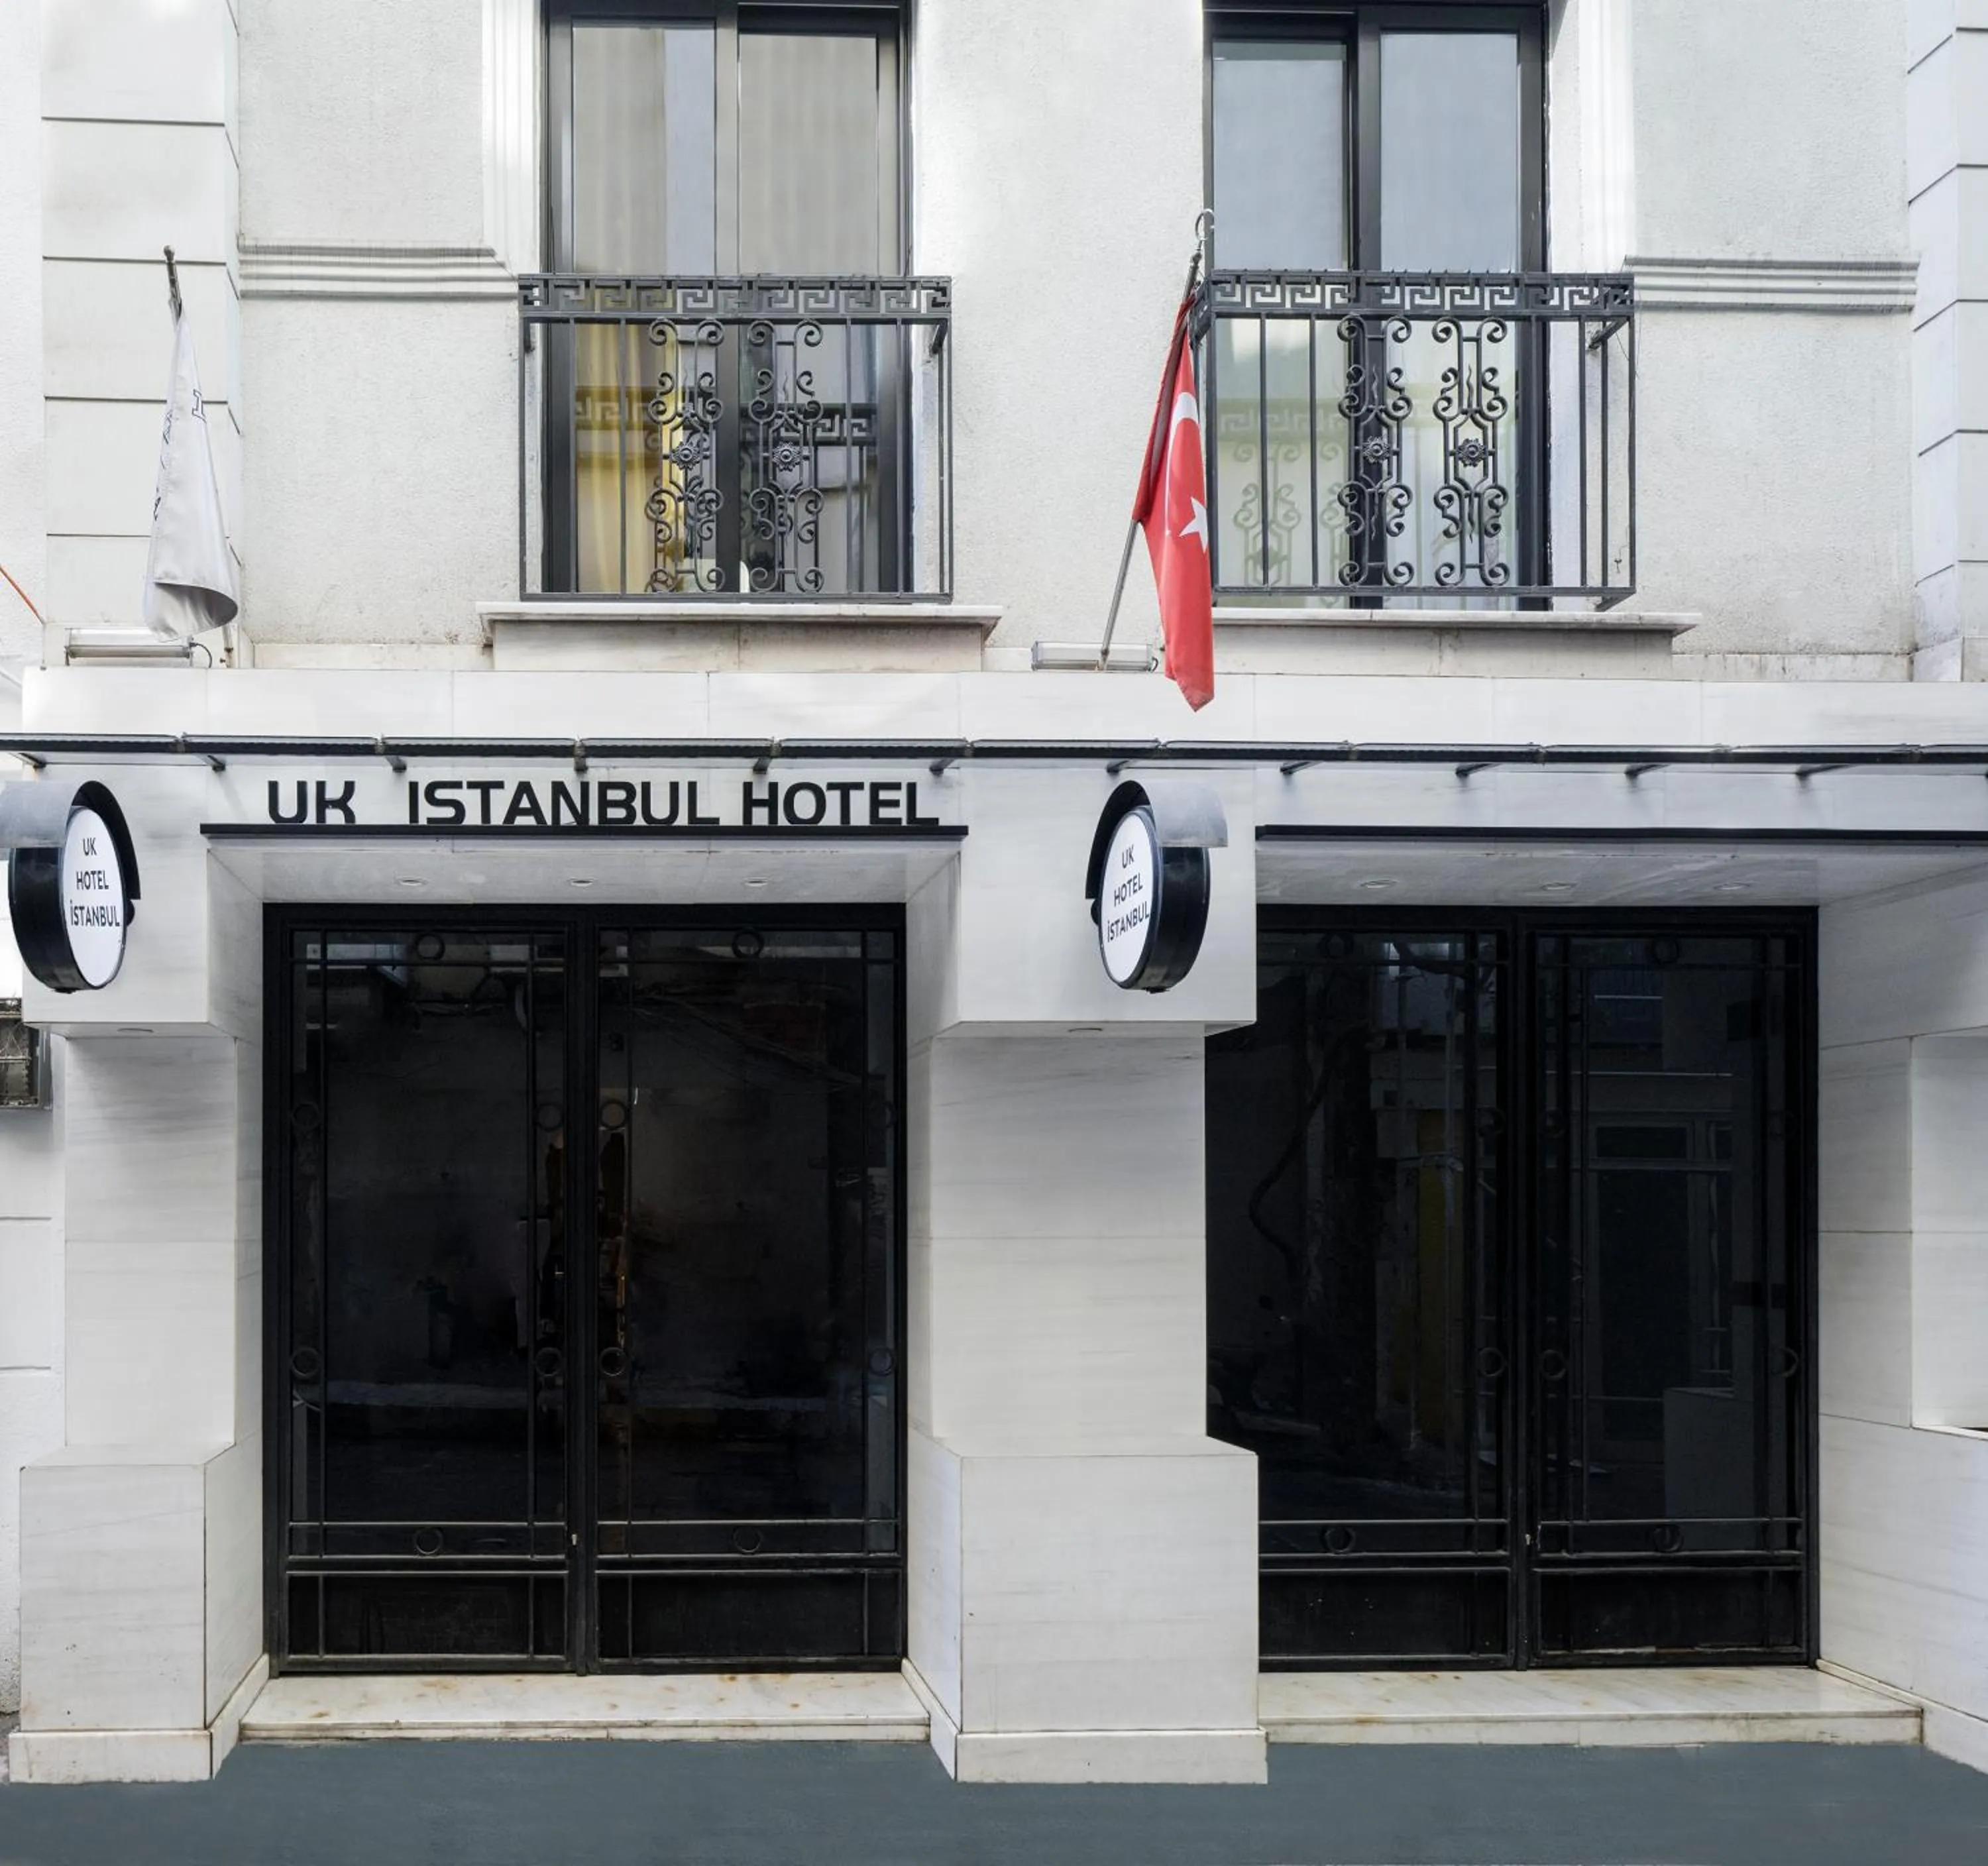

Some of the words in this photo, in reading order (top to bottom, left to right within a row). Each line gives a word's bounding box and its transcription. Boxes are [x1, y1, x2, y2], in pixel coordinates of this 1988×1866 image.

[268, 781, 357, 826] UK
[409, 781, 720, 826] ISTANBUL
[742, 781, 940, 826] HOTEL
[83, 838, 97, 856] UK
[1122, 845, 1134, 869] UK
[76, 870, 109, 891] HOTEL
[1115, 873, 1143, 907] HOTEL
[70, 899, 120, 927] İSTANBUL
[1107, 901, 1150, 943] İSTANBUL
